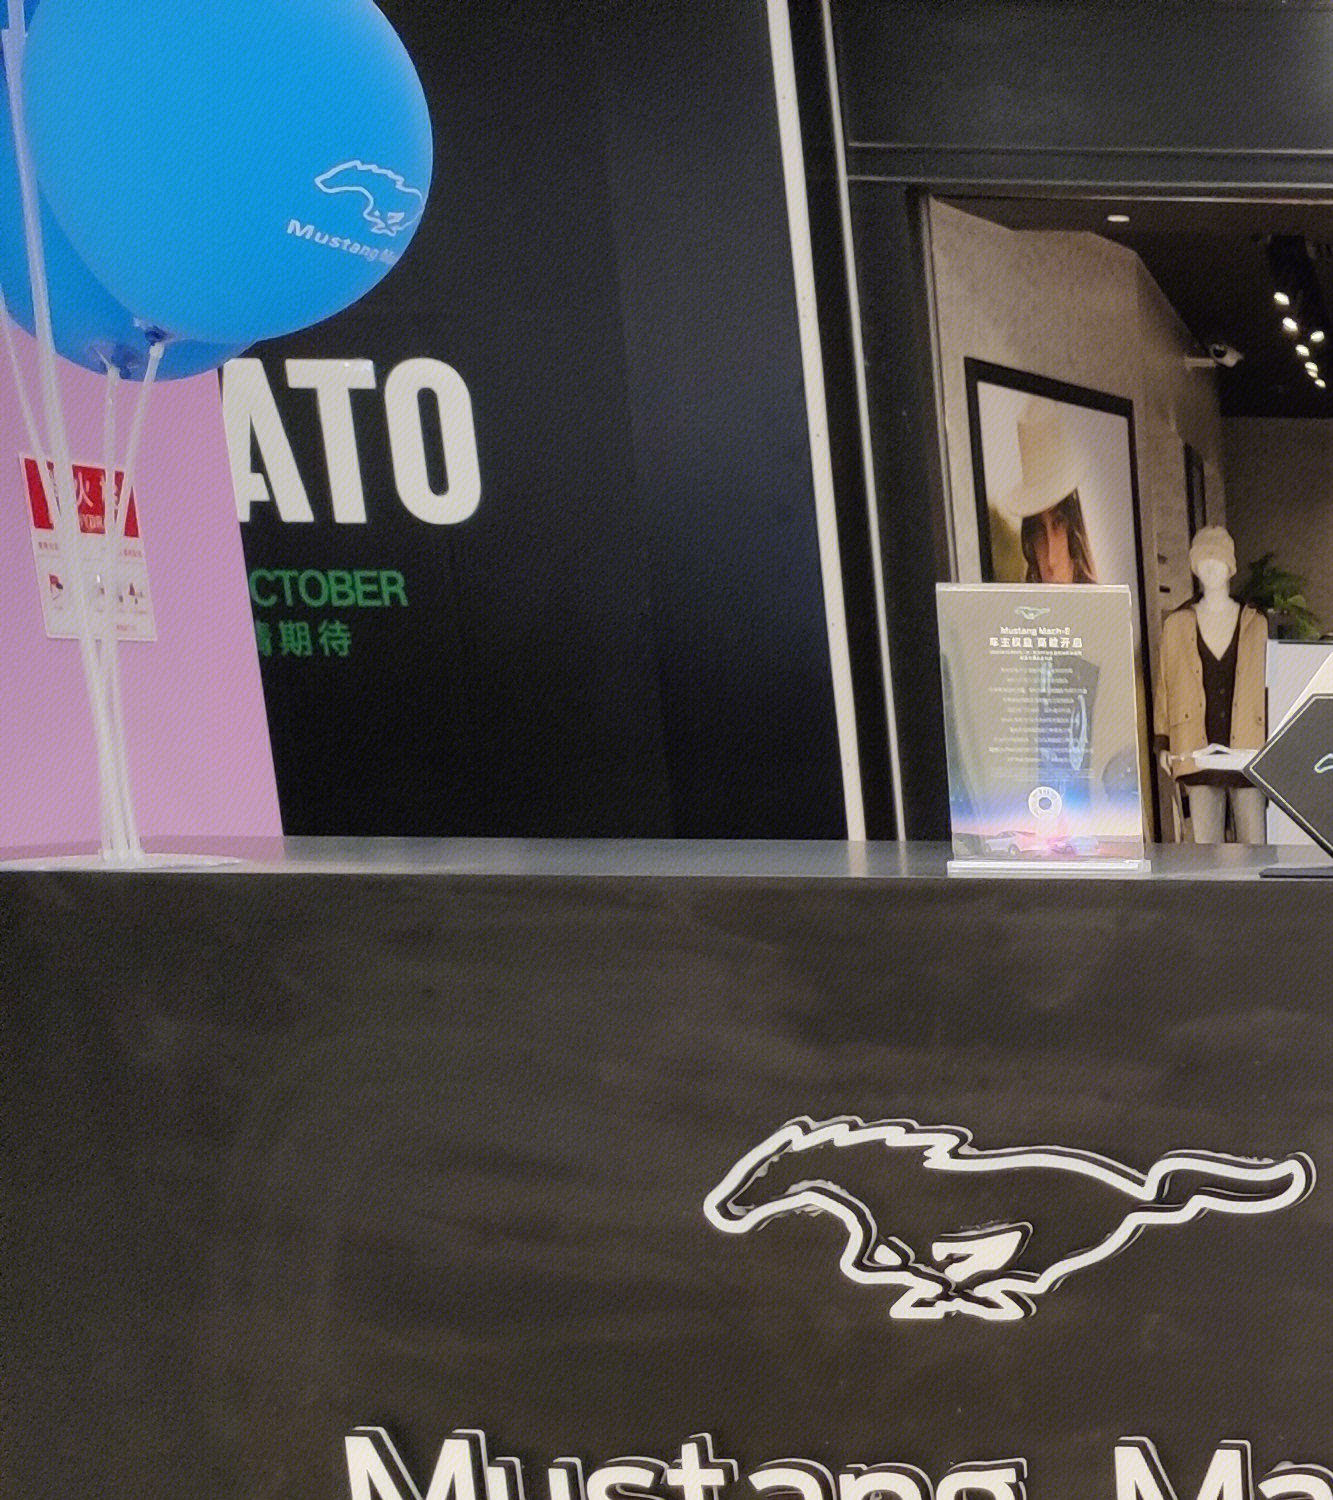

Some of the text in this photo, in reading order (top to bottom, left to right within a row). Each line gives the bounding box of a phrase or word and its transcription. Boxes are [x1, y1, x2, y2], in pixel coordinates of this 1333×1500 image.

[286, 218, 380, 262] Mustang
[222, 357, 482, 525] ATO
[1000, 626, 1038, 637] Mustang
